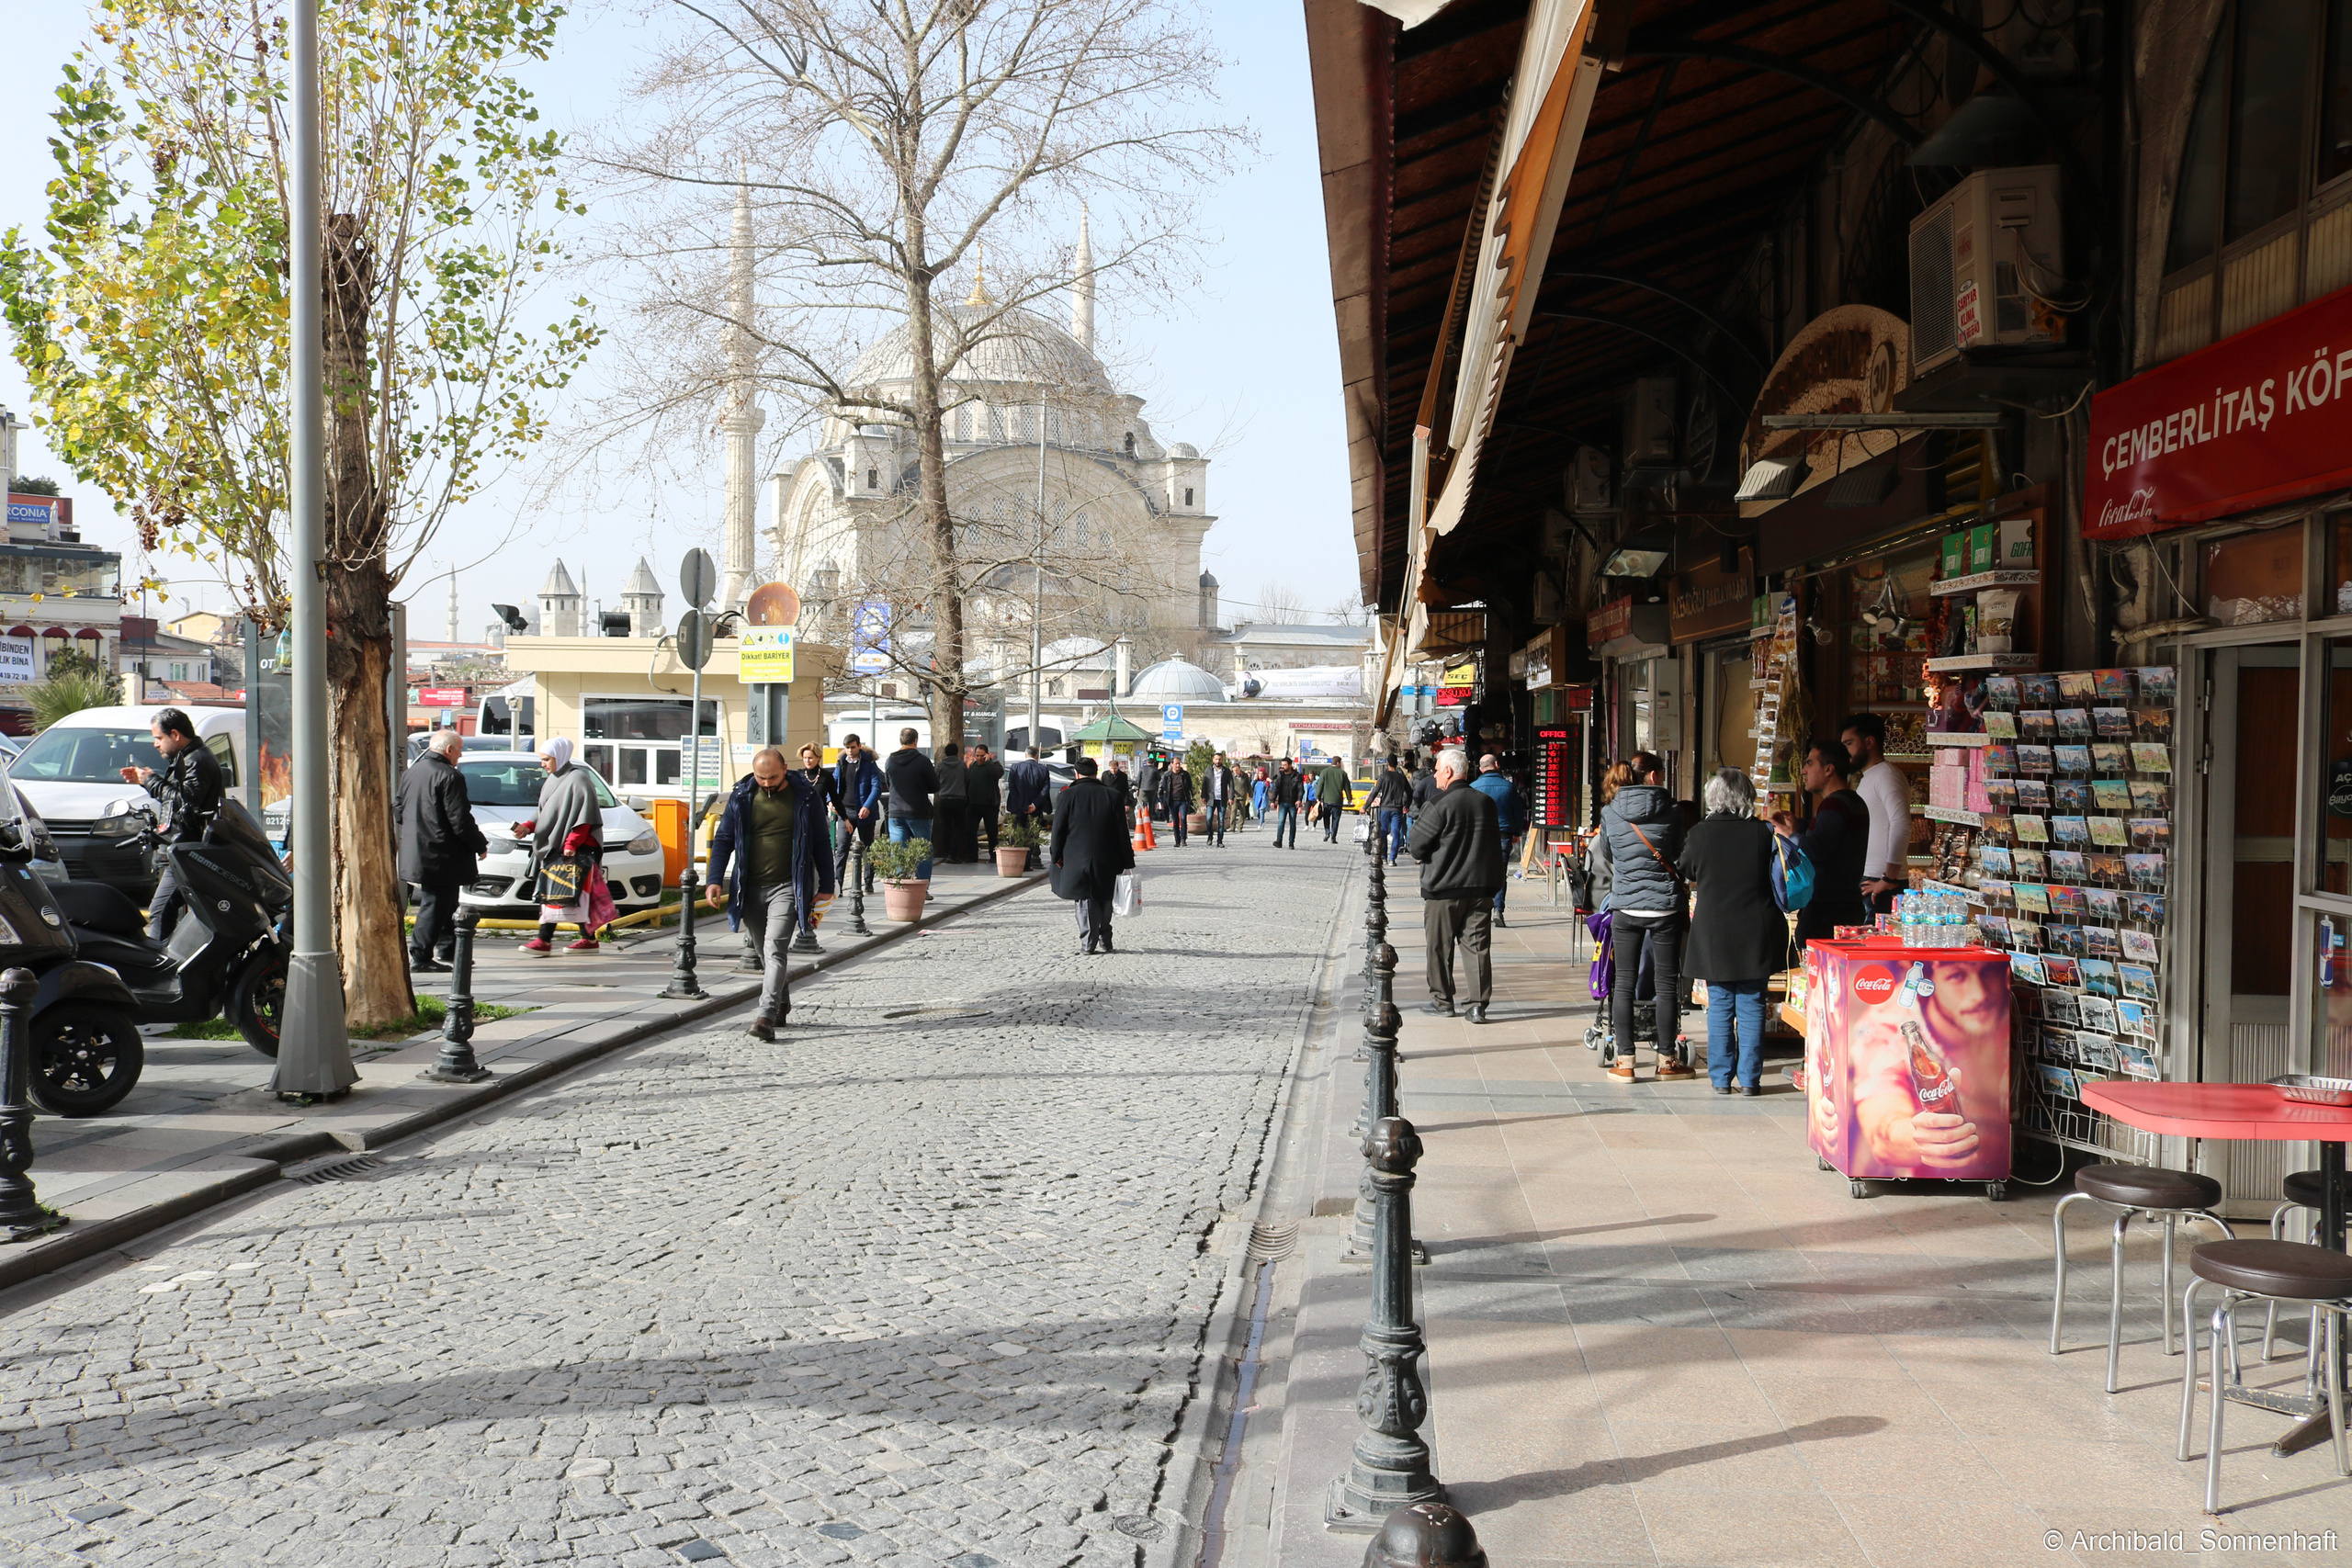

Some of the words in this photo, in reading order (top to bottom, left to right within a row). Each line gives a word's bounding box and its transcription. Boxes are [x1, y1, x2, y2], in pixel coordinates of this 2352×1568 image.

[1873, 359, 1886, 398] 30
[2102, 378, 2275, 481] ÇEMBERLİTAŞ
[12, 656, 28, 666] BİNA
[763, 651, 790, 660] BARİYER
[1856, 978, 1893, 991] Coca-Cola
[1919, 1076, 1955, 1102] Coca-Cola
